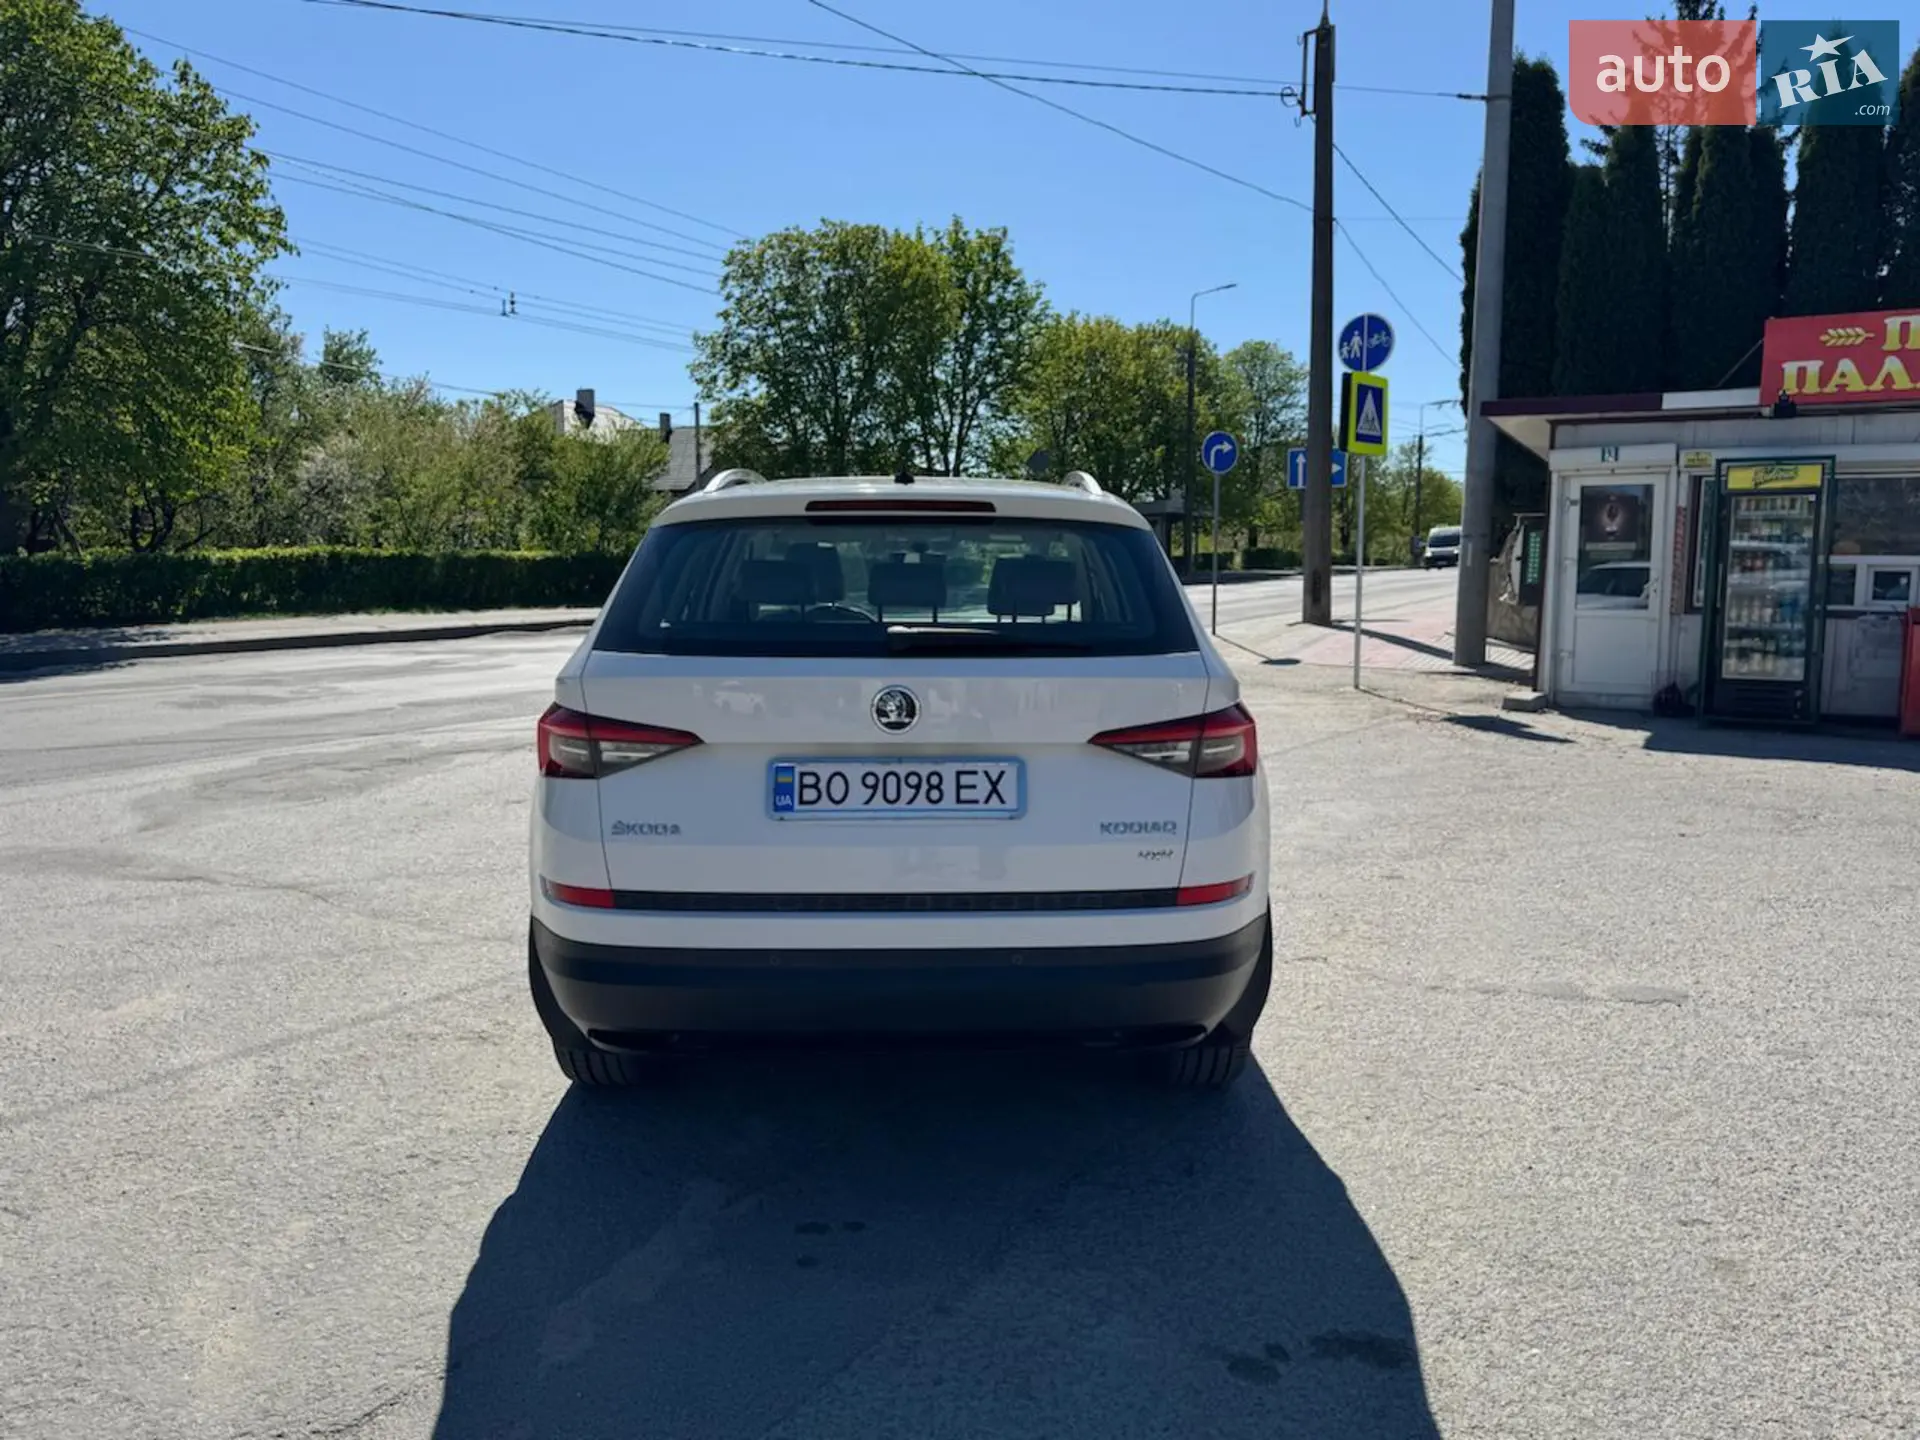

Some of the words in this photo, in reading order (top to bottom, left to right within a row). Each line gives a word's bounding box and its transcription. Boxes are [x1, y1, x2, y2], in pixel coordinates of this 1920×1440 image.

[1779, 355, 1920, 395] ПАЛ
[799, 770, 850, 806] BO
[861, 770, 944, 806] 9098
[955, 769, 1007, 805] EX
[776, 795, 793, 807] UA
[1100, 821, 1177, 835] KODIAQ
